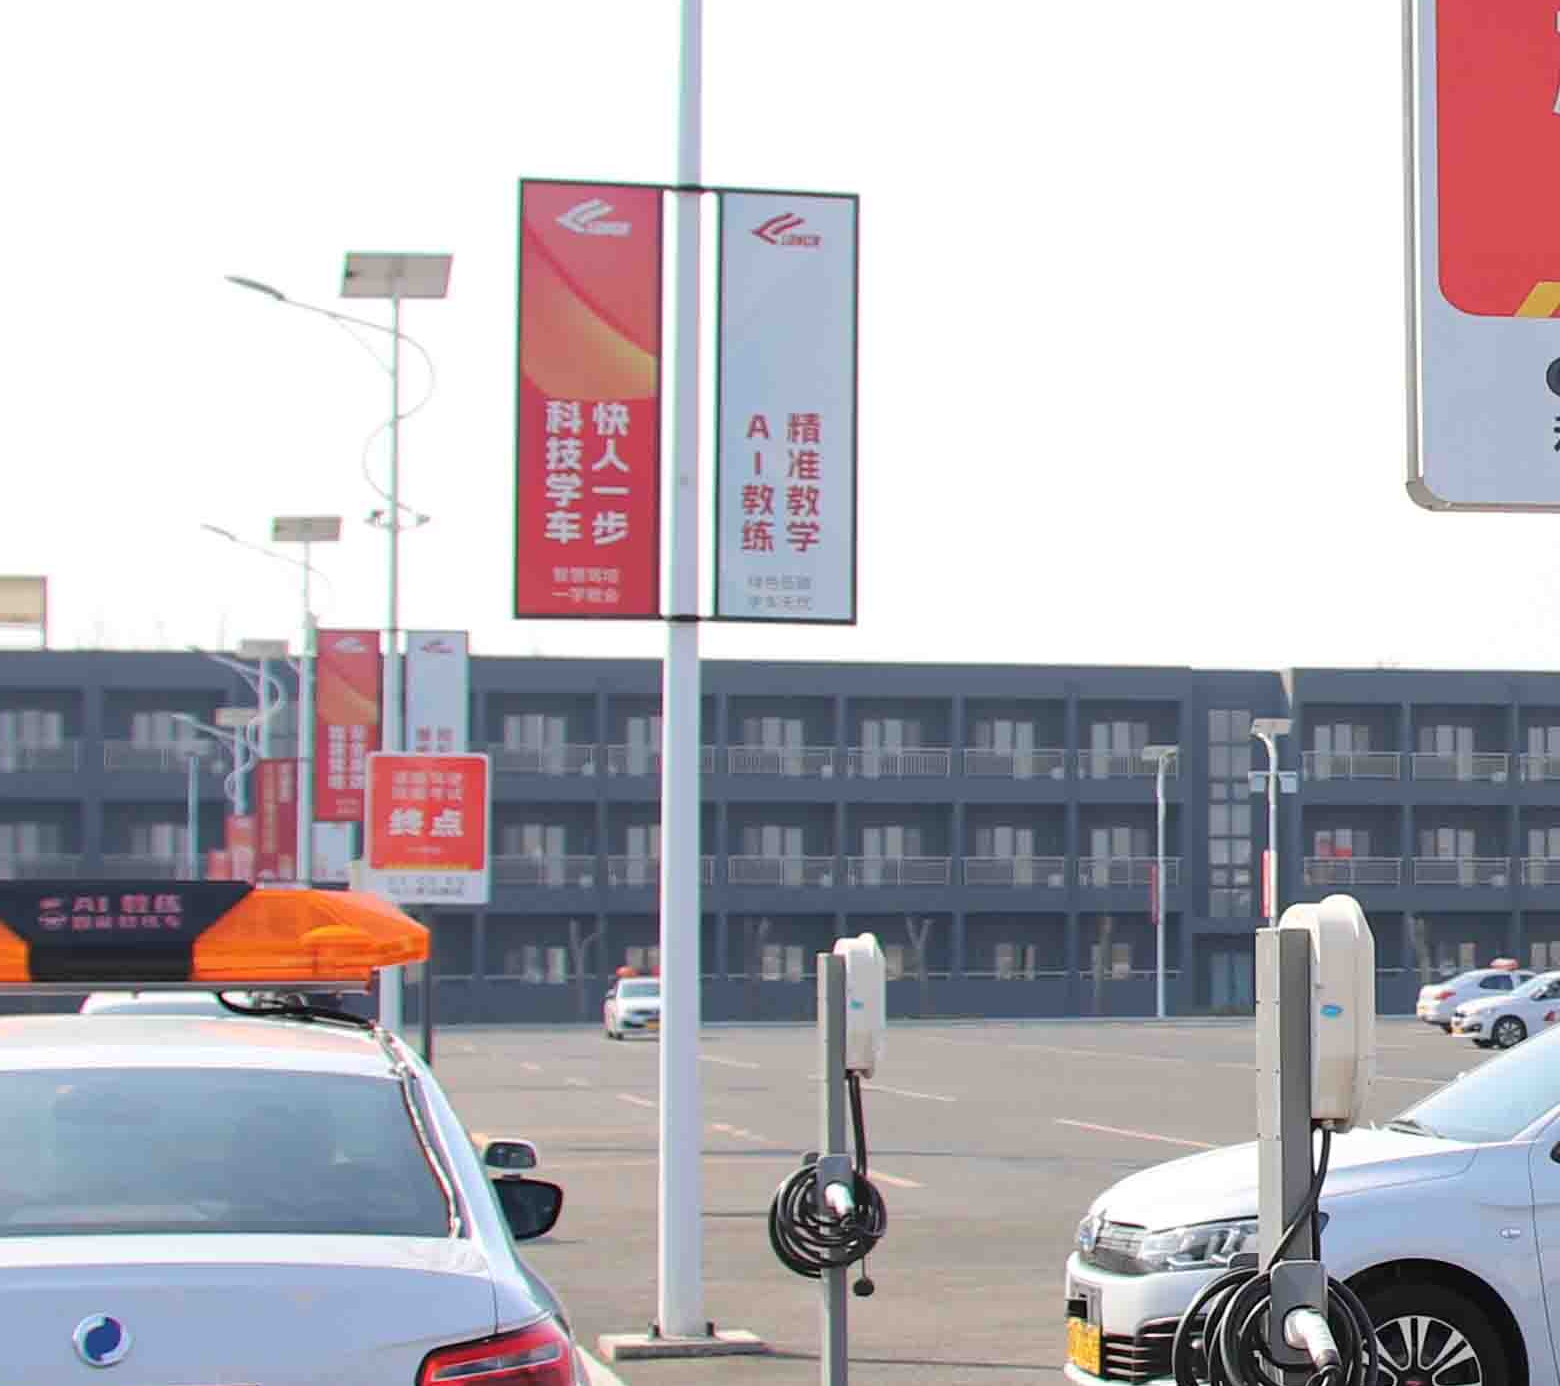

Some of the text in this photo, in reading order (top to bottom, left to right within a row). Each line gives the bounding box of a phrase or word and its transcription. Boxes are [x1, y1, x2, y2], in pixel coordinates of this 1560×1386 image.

[544, 399, 584, 546] 科技学车
[591, 401, 631, 548] 快人一步
[785, 413, 821, 554] 精准教学
[387, 808, 465, 838] 终点
